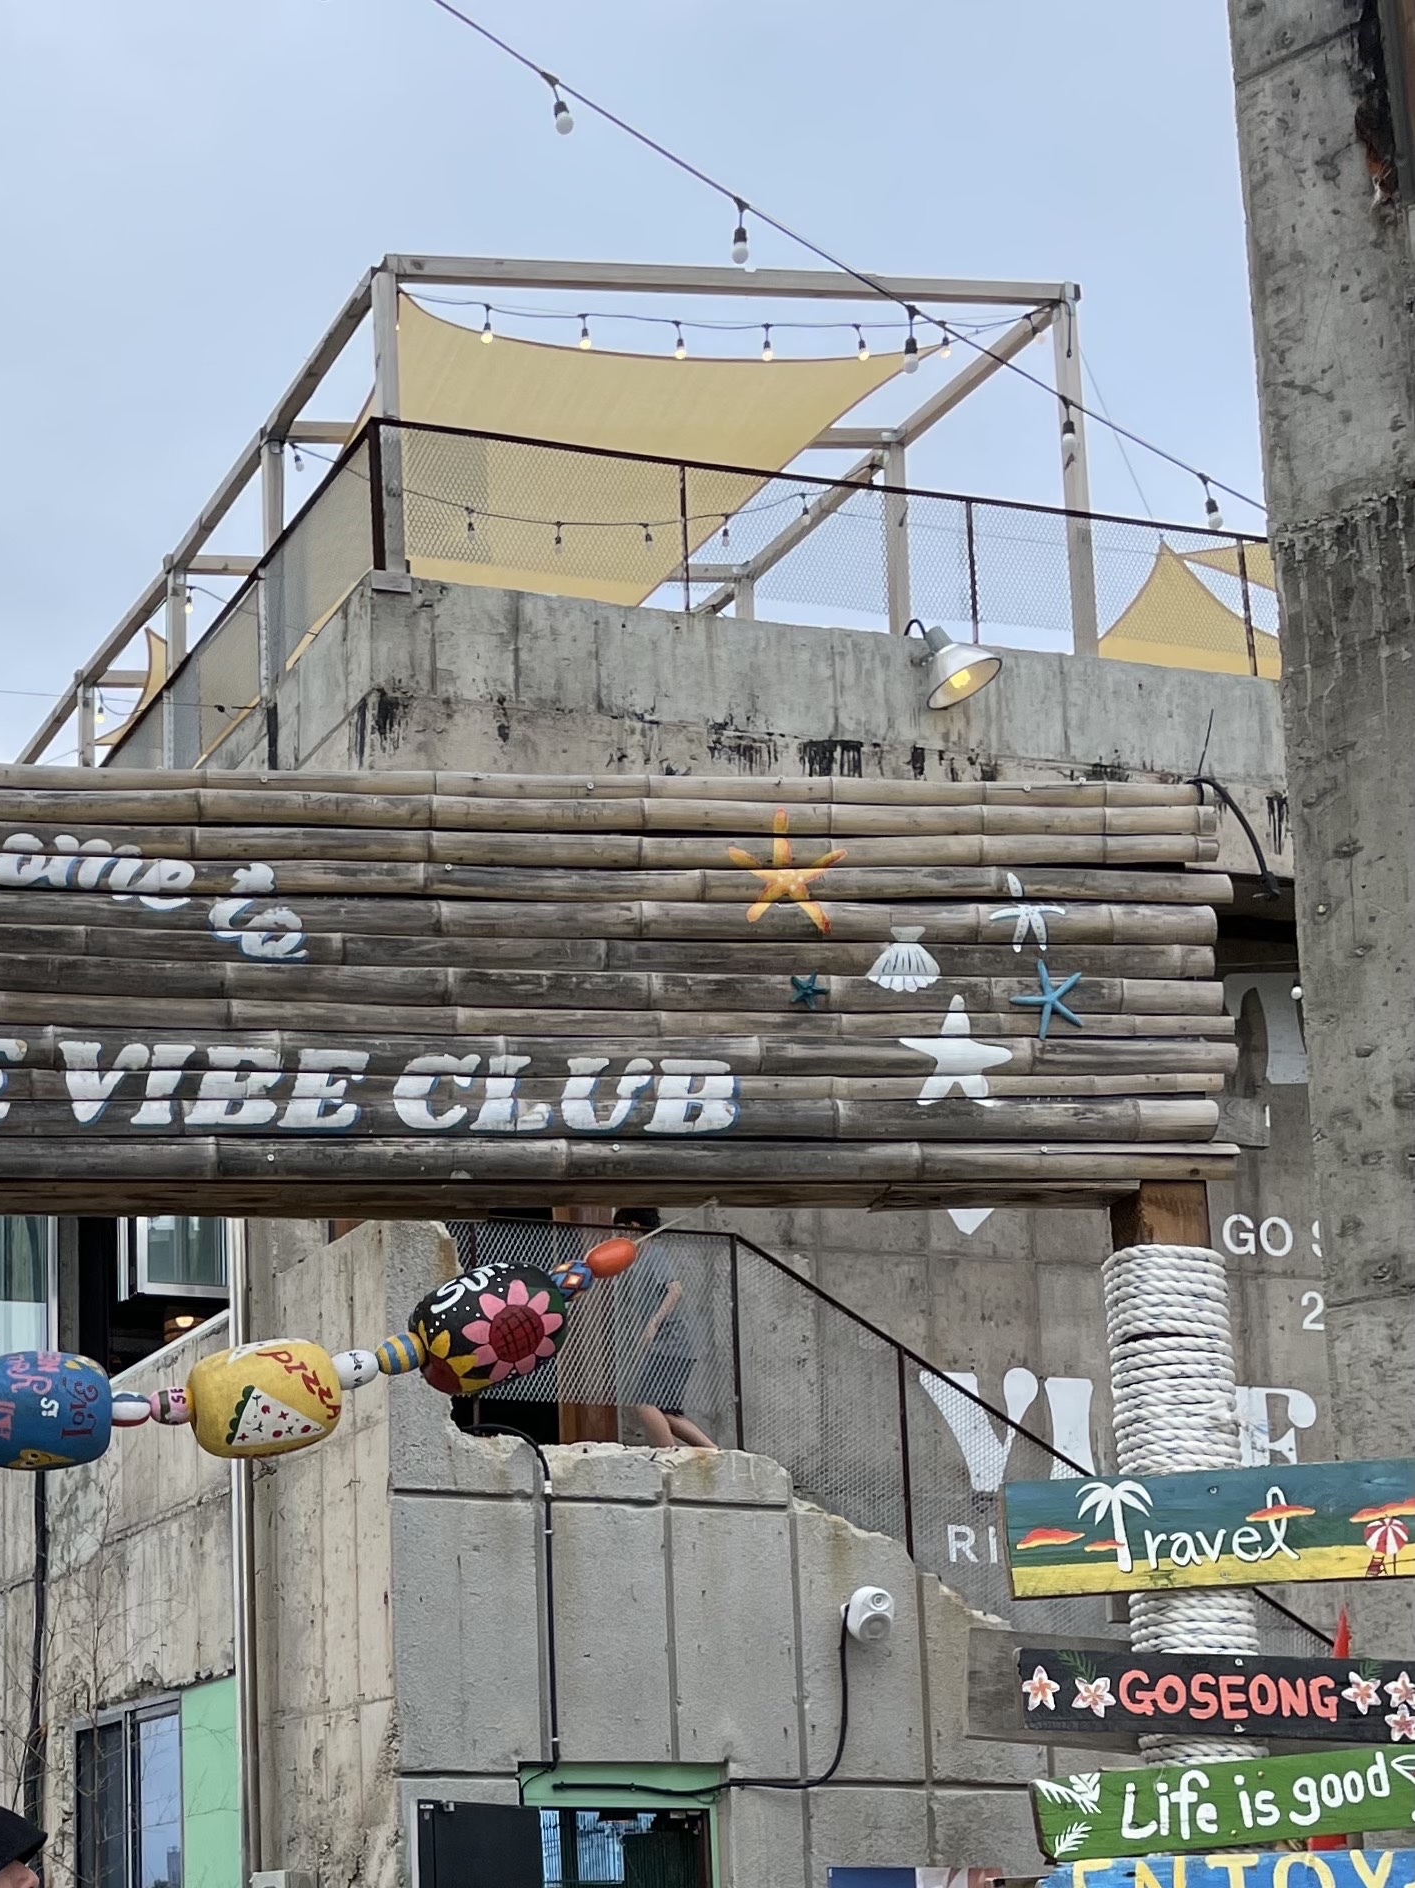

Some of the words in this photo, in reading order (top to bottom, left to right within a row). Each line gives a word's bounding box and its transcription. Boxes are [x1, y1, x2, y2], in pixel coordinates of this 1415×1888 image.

[57, 1040, 370, 1130] VIBE
[391, 1054, 739, 1133] CLUB
[1222, 1213, 1294, 1256] GO
[256, 1350, 342, 1420] PIZZA
[1076, 1480, 1301, 1573] Travel
[1119, 1669, 1340, 1722] GOSEONG
[1121, 1768, 1219, 1840] Life
[1235, 1773, 1281, 1829] is
[1290, 1751, 1392, 1827] good
